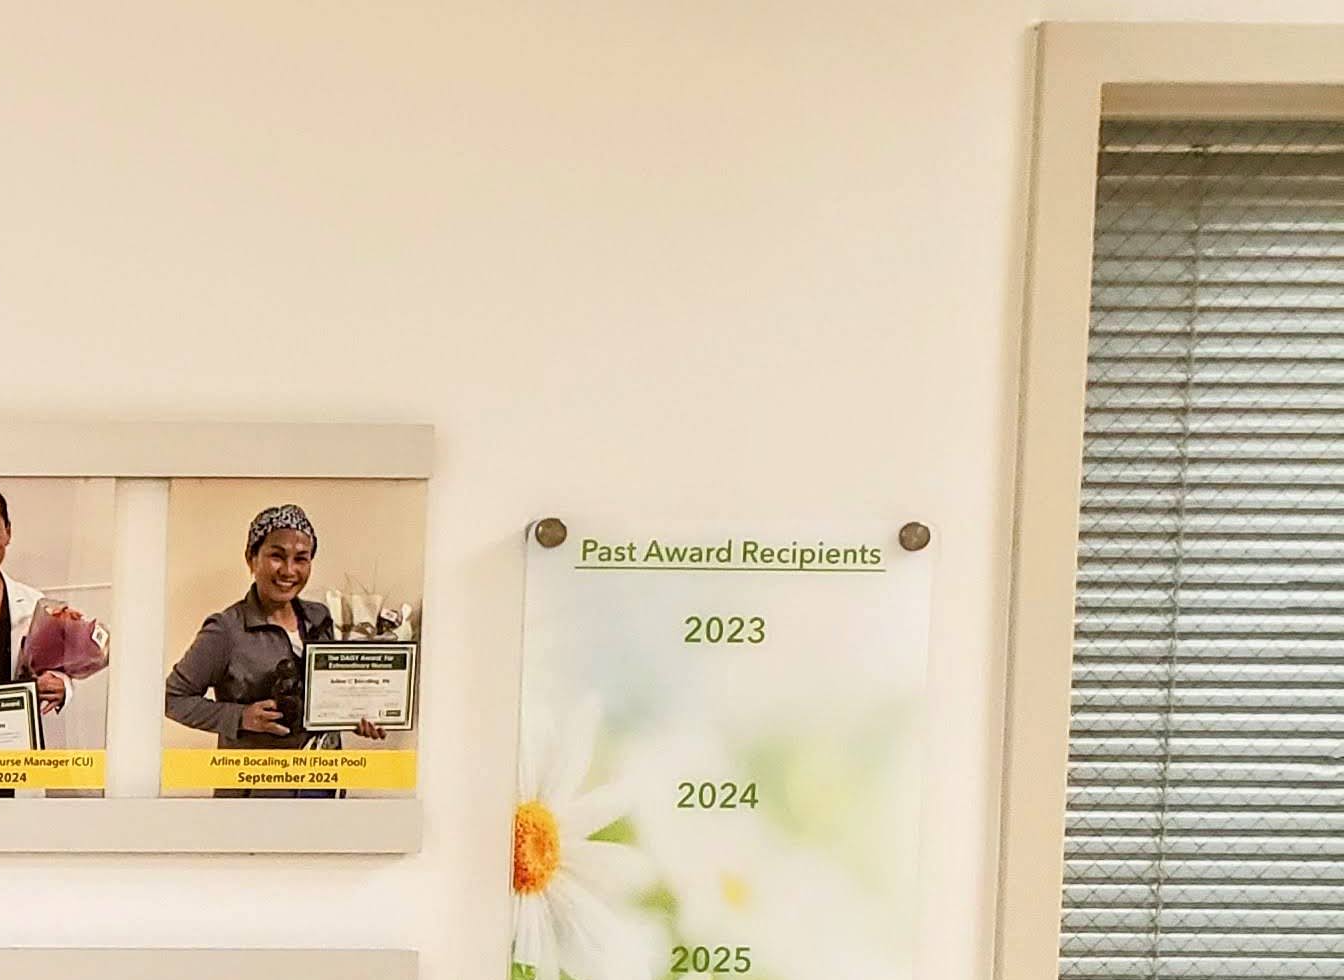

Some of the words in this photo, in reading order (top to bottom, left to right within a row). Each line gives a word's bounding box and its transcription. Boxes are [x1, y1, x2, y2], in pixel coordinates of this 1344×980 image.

[581, 539, 636, 562] Past
[642, 538, 732, 563] Award
[742, 540, 880, 569] Recipients
[684, 616, 765, 643] 2023
[23, 756, 69, 768] Manager
[71, 756, 93, 767] ICU)
[209, 756, 241, 766] Arline
[243, 756, 290, 768] Bocaling,
[292, 756, 307, 766] RN
[309, 756, 338, 767] (Float
[340, 756, 366, 768] Pool)
[237, 771, 306, 785] September
[308, 772, 338, 783] 2024
[676, 782, 758, 808] 2024
[670, 944, 751, 975] 2025
